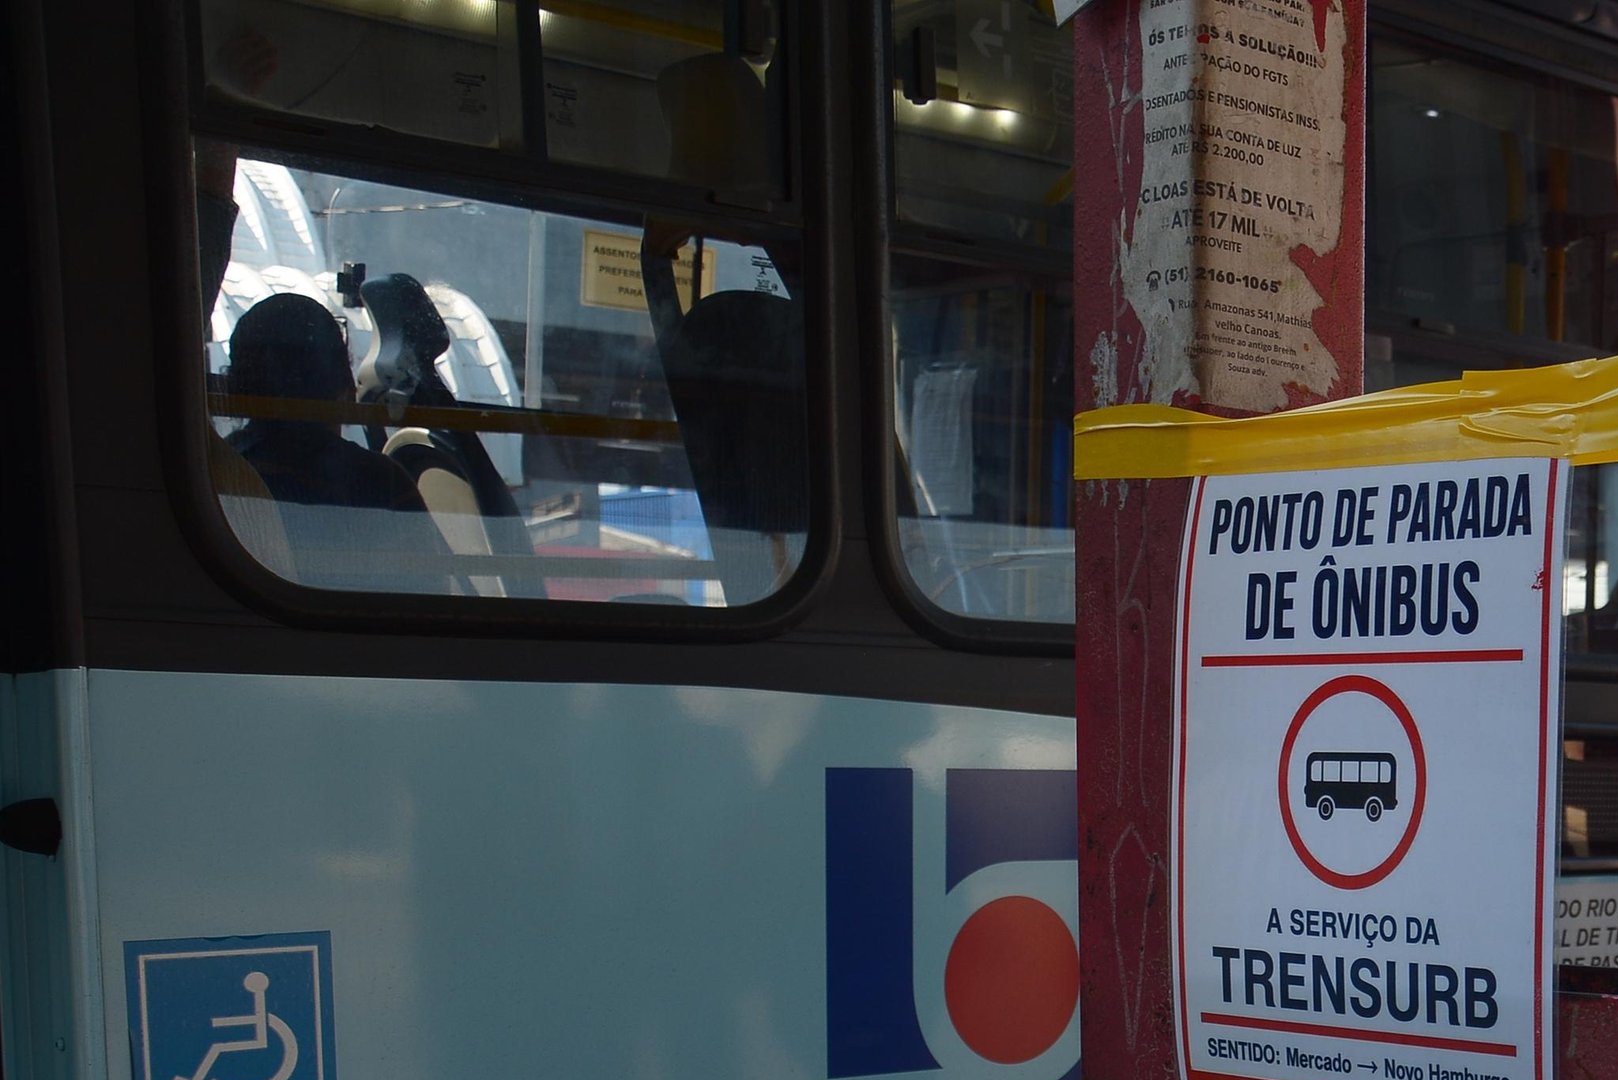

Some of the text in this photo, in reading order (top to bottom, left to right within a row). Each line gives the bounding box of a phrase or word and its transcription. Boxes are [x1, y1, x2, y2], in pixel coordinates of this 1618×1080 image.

[1225, 30, 1235, 44] A
[1239, 33, 1317, 68] SOLUÇÃO!!!
[1163, 53, 1289, 86] ANTEPAÇÃO DO FGTS
[1208, 91, 1215, 102] E
[1217, 92, 1294, 124] PENSIONISTAS
[1296, 113, 1321, 132] INSS.
[1181, 123, 1195, 137] NA
[1200, 123, 1223, 139] SUA
[1226, 129, 1264, 149] CONTA
[1267, 139, 1280, 153] DE
[1282, 143, 1302, 159] LUZ
[1192, 141, 1209, 154] R$
[1213, 144, 1264, 166] 2.200,00
[1153, 181, 1188, 202] LOAS
[1193, 179, 1237, 202] ESTÁ
[1241, 188, 1262, 208] DE
[1266, 193, 1315, 221] VOLTA
[1171, 207, 1260, 238] ATÉ 17 MIL
[593, 245, 641, 260] ASSENTO
[1185, 234, 1243, 253] APROVEITE
[598, 264, 641, 279] PREFERE
[1164, 266, 1280, 293] (51) 2160-1065
[1204, 299, 1256, 319] Amazonas
[1211, 332, 1236, 346] frente
[1236, 338, 1247, 347] ao
[1248, 340, 1273, 354] antigo
[1215, 319, 1282, 340] velho Canoas.
[1226, 351, 1236, 360] ao
[1237, 350, 1254, 362] lado
[1254, 355, 1265, 364] do
[1227, 362, 1268, 377] Souza adv.
[1208, 473, 1533, 555] PONTO DE PARADA
[1244, 555, 1481, 641] DE ÔNIBUS
[1586, 898, 1617, 918] RIO
[1266, 908, 1440, 949] A SERVIÇO DA
[1576, 928, 1601, 947] DE
[1212, 945, 1499, 1029] TRENSURB
[1207, 1037, 1281, 1066] SENTIDO:
[1286, 1046, 1352, 1074] Mercado
